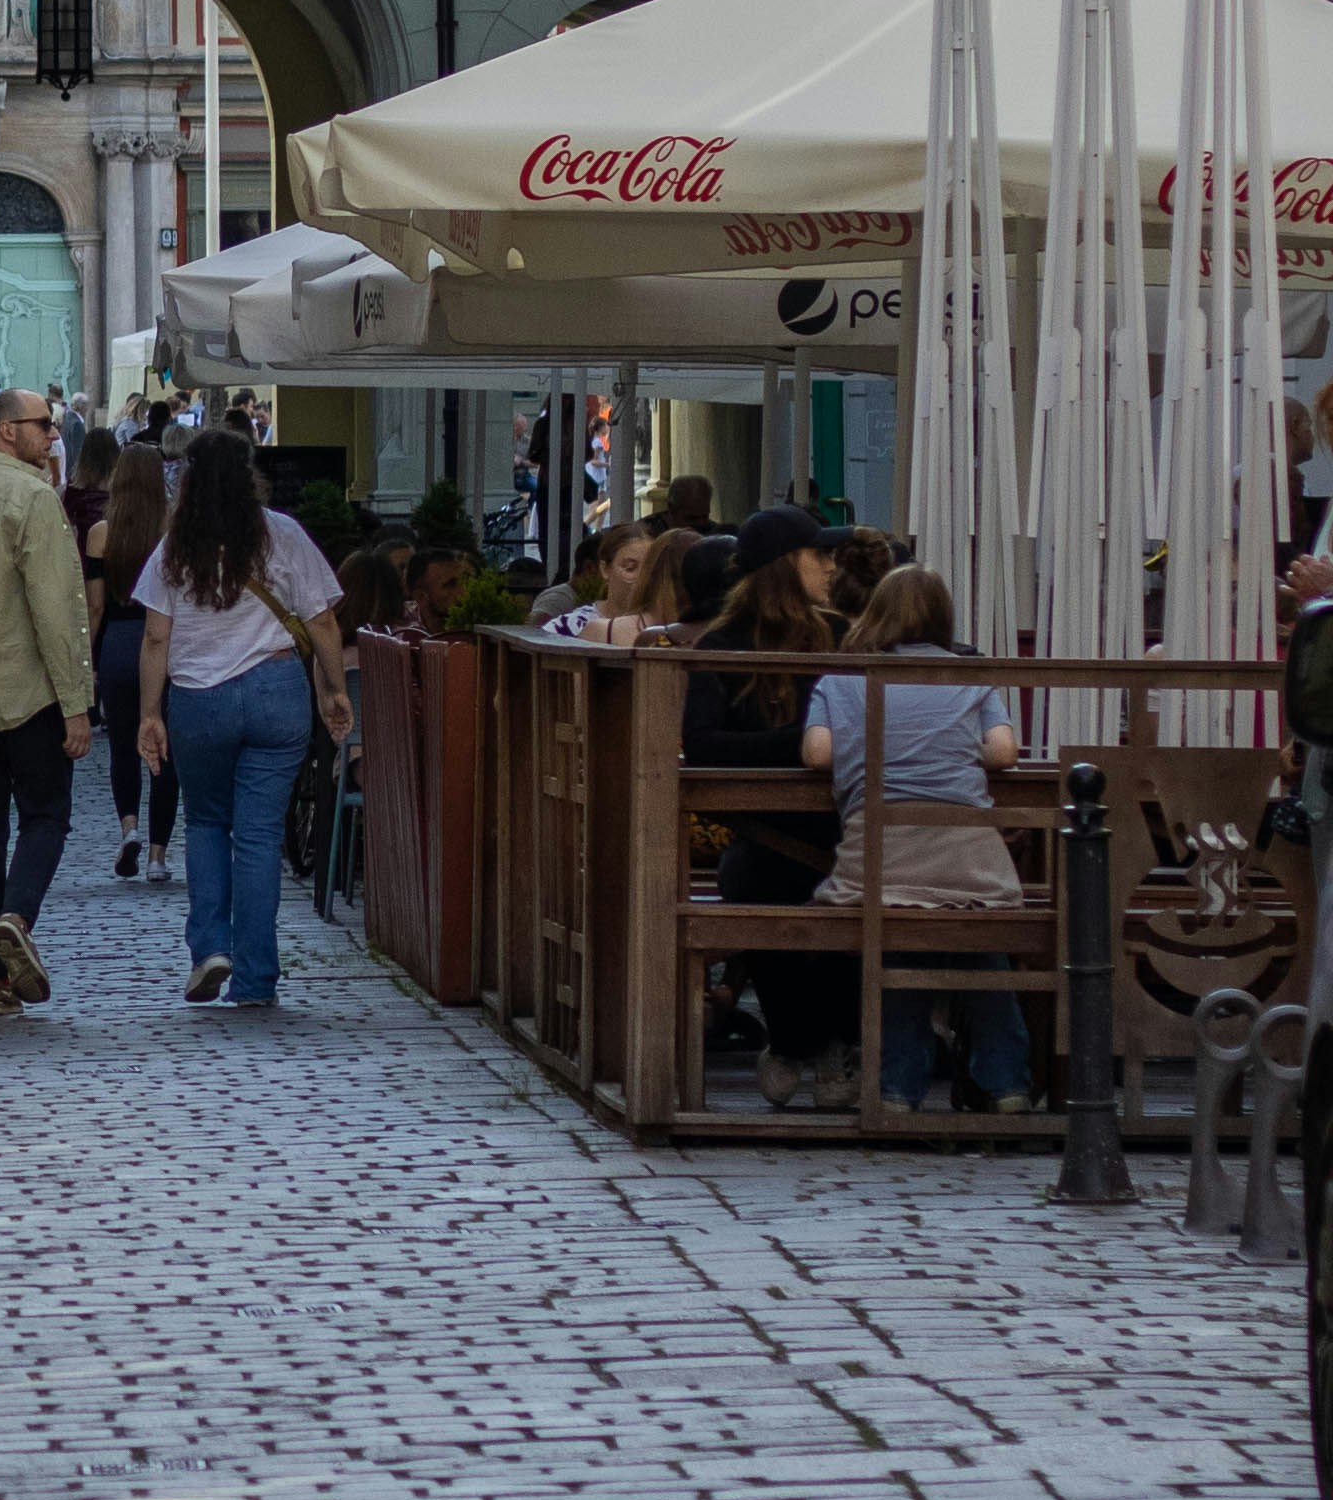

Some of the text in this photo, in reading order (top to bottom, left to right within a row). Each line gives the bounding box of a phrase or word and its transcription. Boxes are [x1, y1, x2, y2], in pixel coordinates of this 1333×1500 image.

[519, 133, 739, 203] Coca-Cola
[364, 284, 385, 329] pepsi
[849, 282, 981, 329] pei
